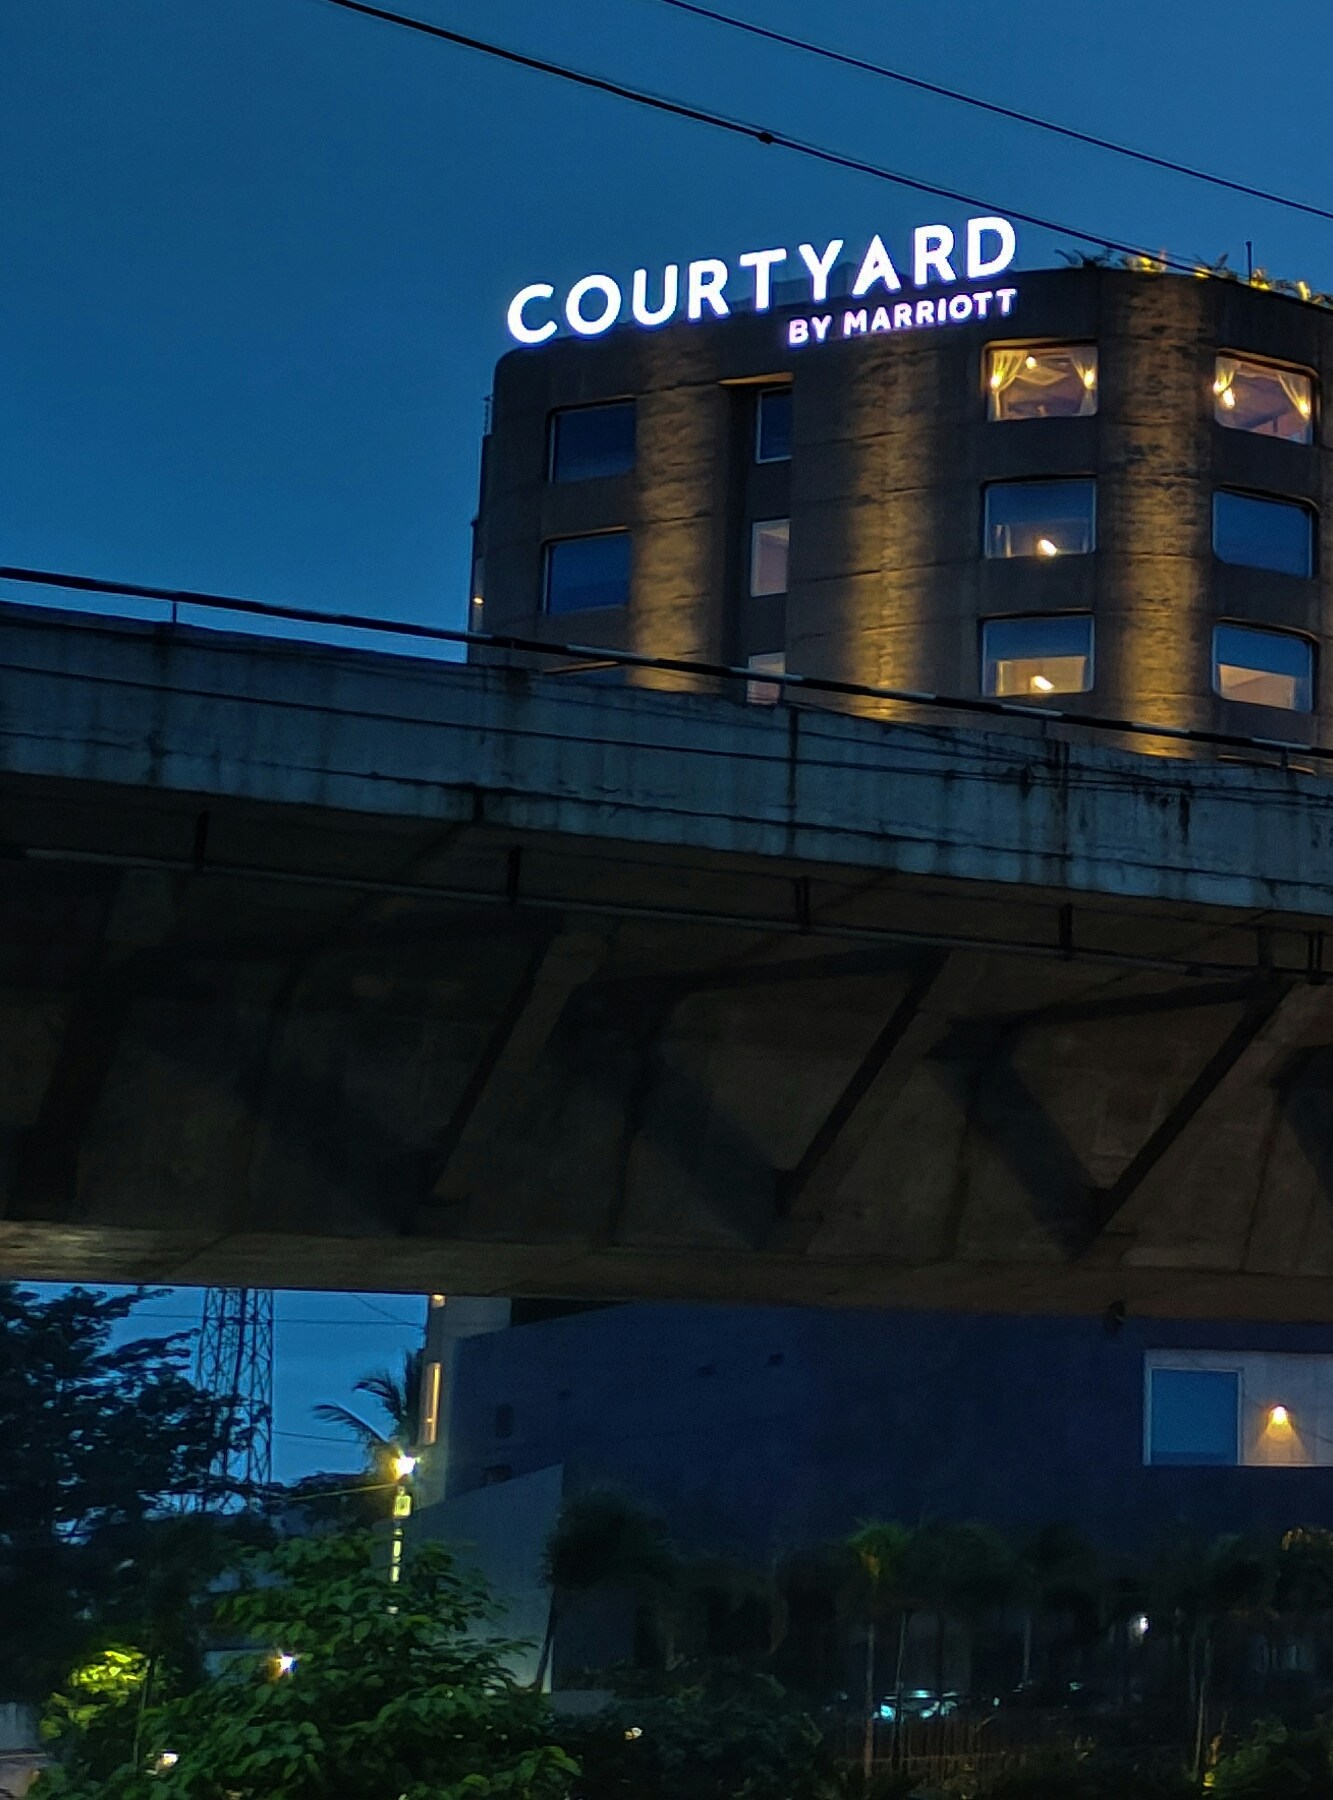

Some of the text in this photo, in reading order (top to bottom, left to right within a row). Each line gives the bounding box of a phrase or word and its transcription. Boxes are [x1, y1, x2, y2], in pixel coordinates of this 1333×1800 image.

[507, 216, 1016, 344] COURTYARD
[789, 288, 1016, 344] BY MARRIOTT
